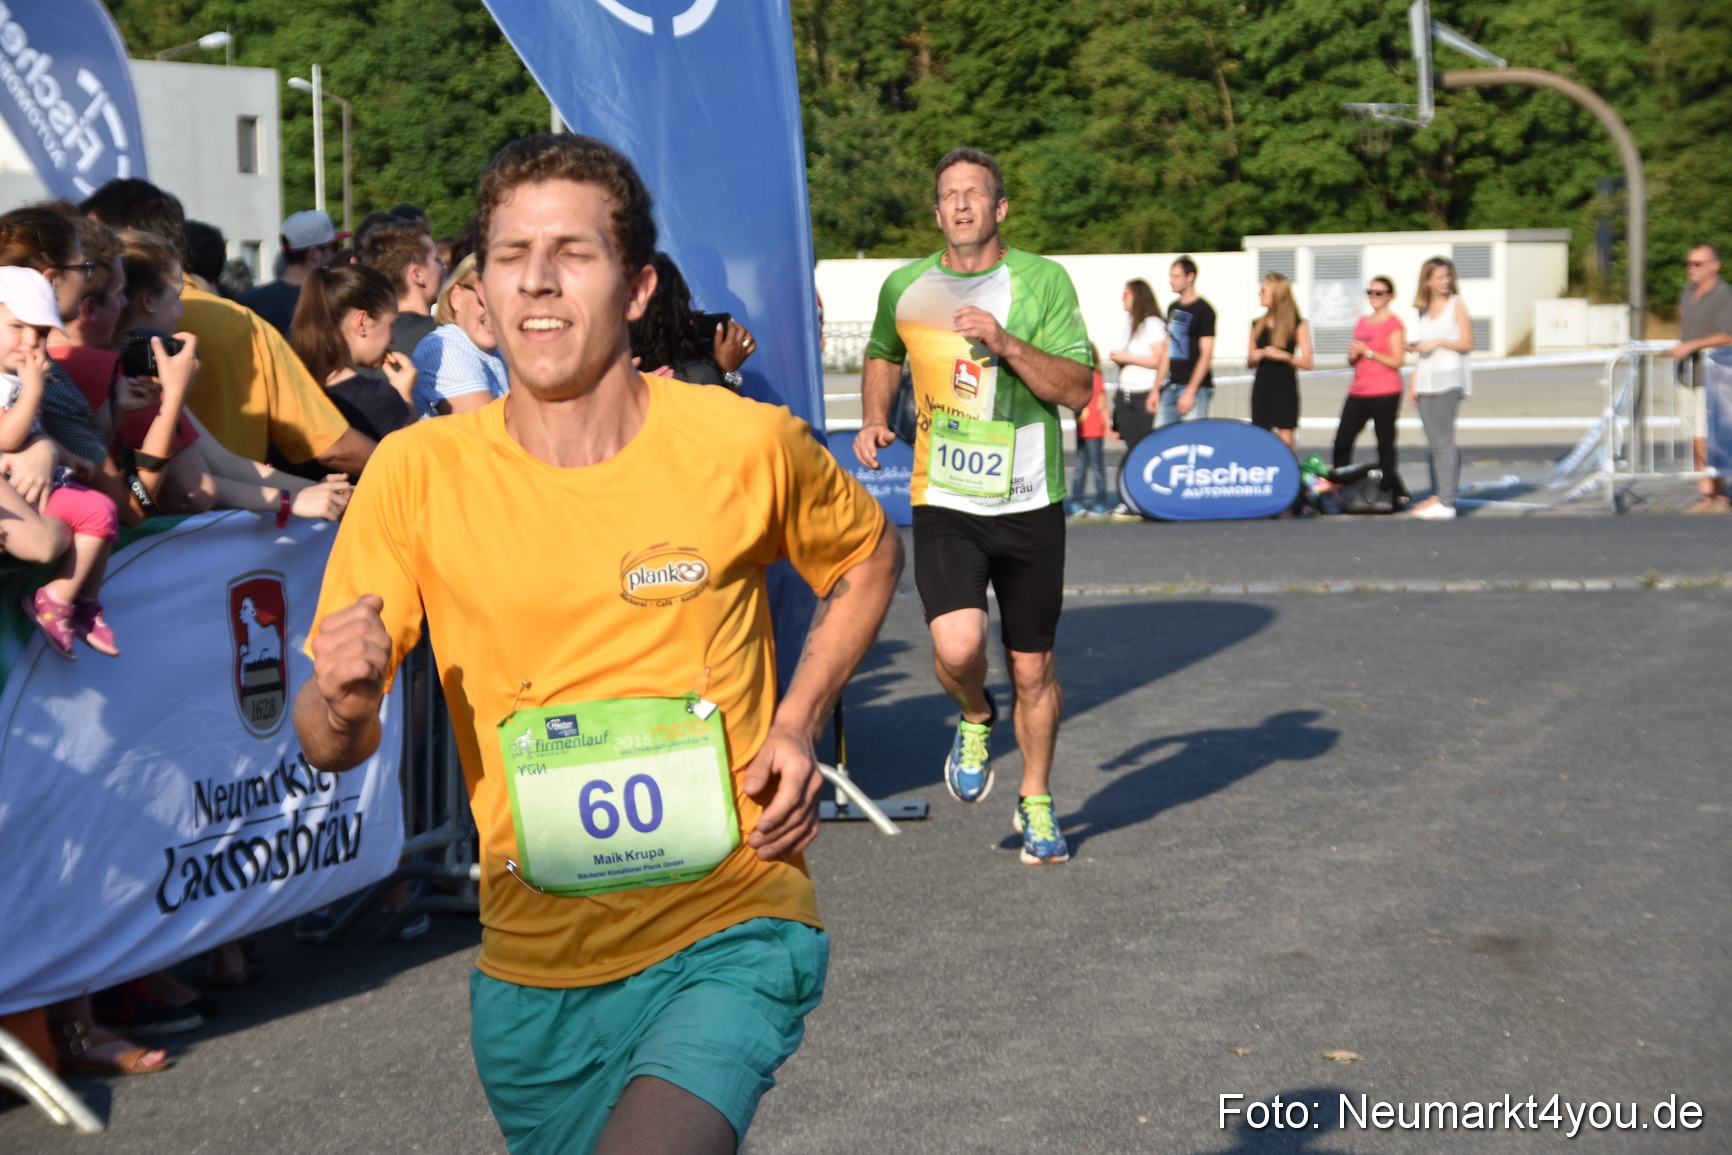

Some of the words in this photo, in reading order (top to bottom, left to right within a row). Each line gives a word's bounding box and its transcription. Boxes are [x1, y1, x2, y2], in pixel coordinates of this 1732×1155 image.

[937, 443, 1003, 477] 1002
[1168, 461, 1281, 488] Fischer
[127, 474, 152, 506] SONY
[1181, 484, 1273, 500] AUTOMOBILE
[628, 563, 684, 591] plank
[251, 697, 276, 722] 1628
[535, 730, 609, 752] firmenlauf
[578, 773, 664, 839] 60
[577, 870, 606, 880] Bäckerei
[607, 865, 642, 877] Konditorei
[643, 862, 661, 871] Plank
[663, 859, 685, 868] GmbH
[593, 852, 624, 866] Maik
[624, 848, 665, 862] Krupa
